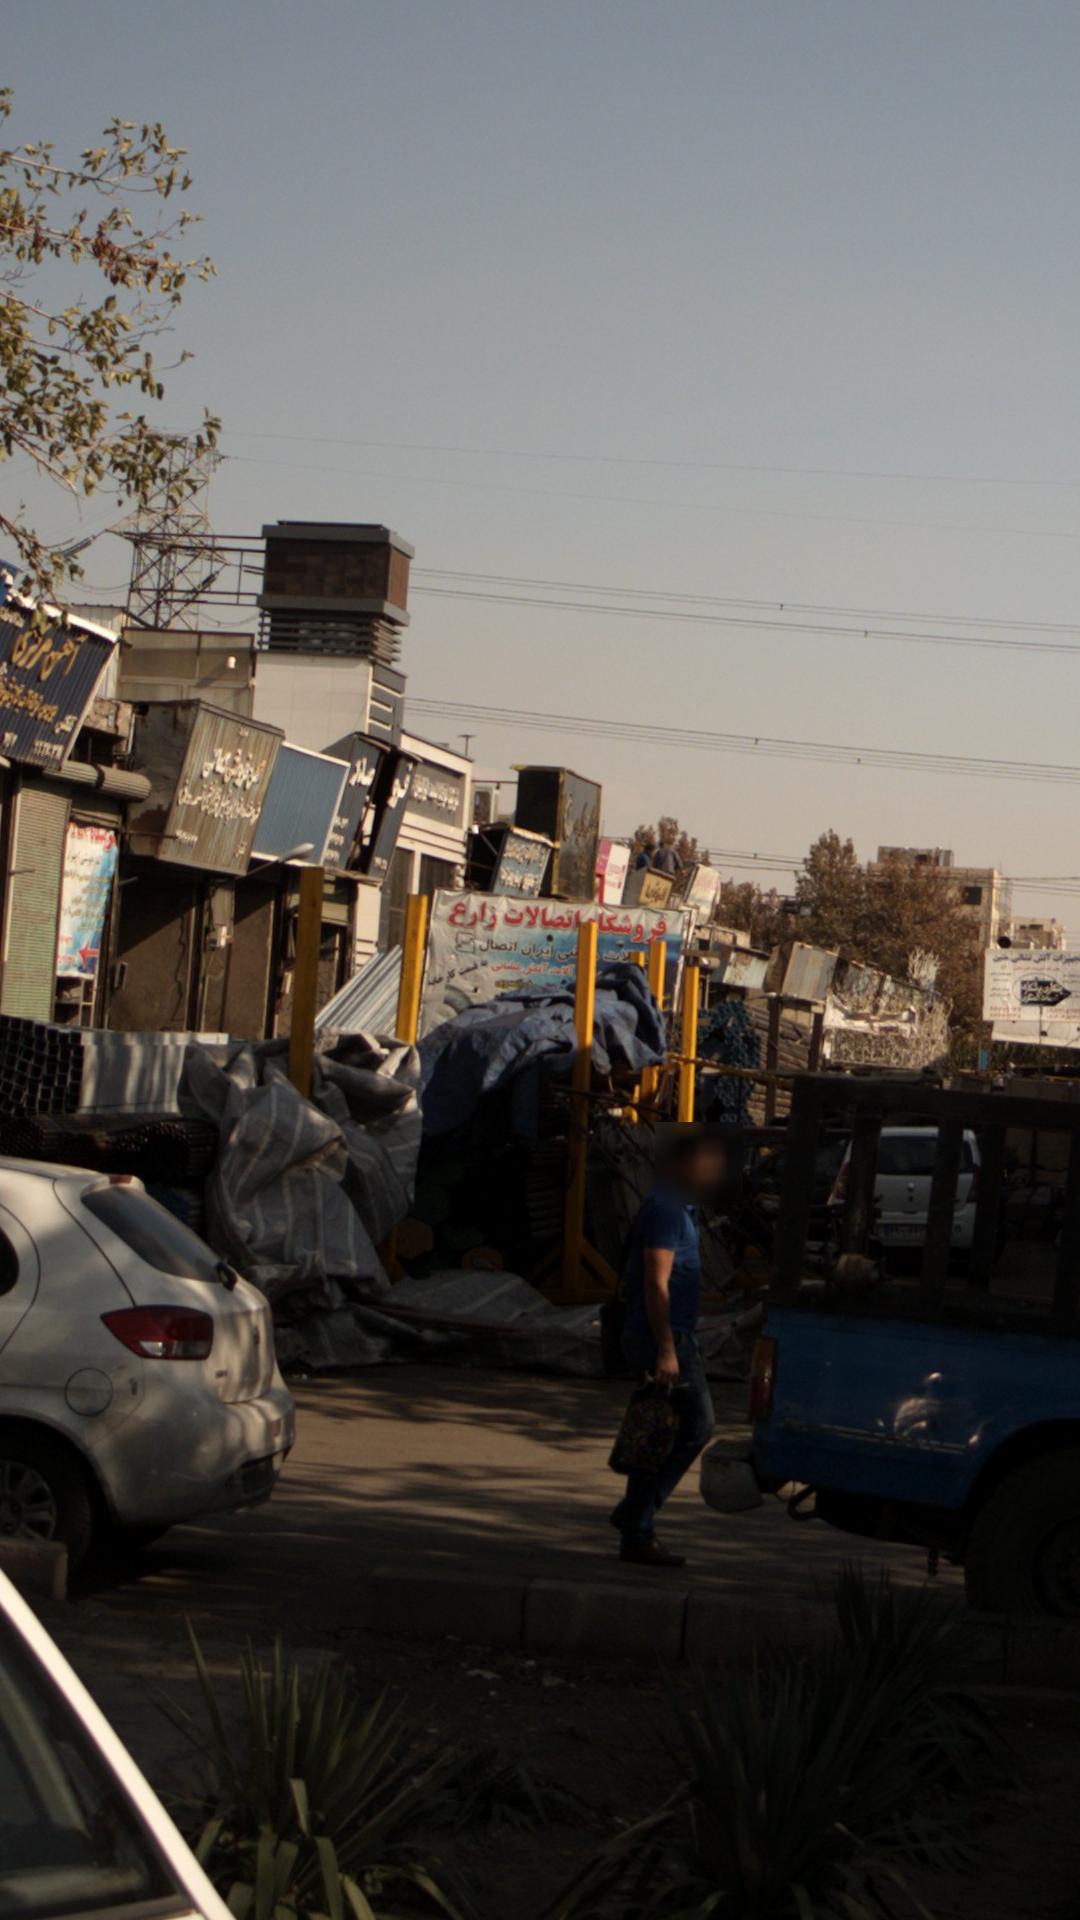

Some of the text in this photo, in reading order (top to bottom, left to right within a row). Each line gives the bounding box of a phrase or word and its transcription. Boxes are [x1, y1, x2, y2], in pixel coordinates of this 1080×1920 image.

[448, 901, 497, 930] زارع
[504, 905, 581, 930] اتصالات
[479, 939, 517, 952] اتصال
[521, 943, 554, 957] ایران
